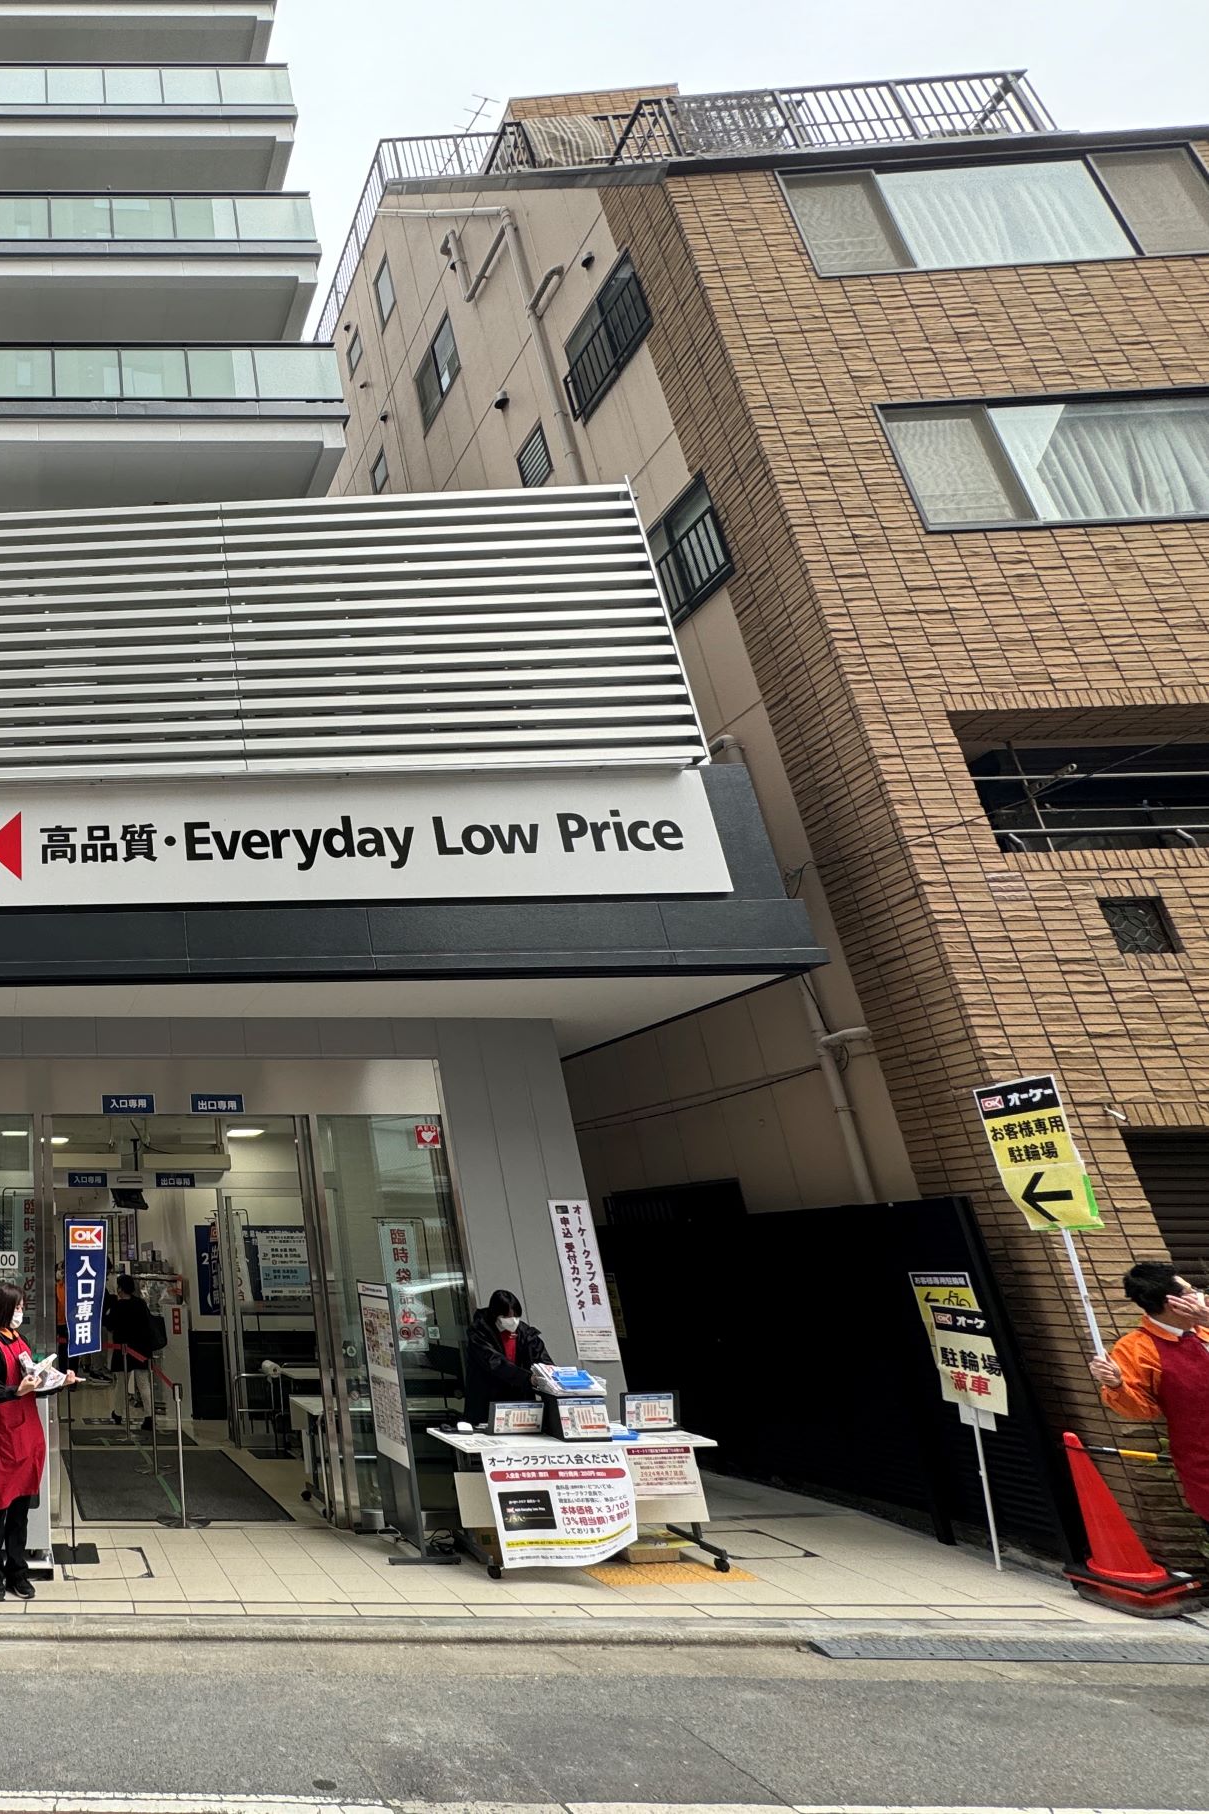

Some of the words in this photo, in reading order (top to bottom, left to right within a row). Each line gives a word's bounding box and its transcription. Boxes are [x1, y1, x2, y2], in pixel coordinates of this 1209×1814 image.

[432, 816, 539, 856] Low
[557, 810, 684, 853] Price
[110, 1099, 147, 1109] 入口専用
[198, 1100, 237, 1110] 出口専用
[981, 1096, 1004, 1111] OK
[1007, 1089, 1053, 1106] オーケー
[990, 1115, 1066, 1142] お客様専用
[1007, 1141, 1059, 1163] 駐輪場
[71, 1227, 102, 1244] OK
[572, 1205, 602, 1306] オーケークラブ会員
[75, 1256, 97, 1345] 入口専用
[940, 1347, 1001, 1377] 駐輪場
[950, 1370, 992, 1396] 満車
[488, 1454, 619, 1466] オーケークラブにご入会ください
